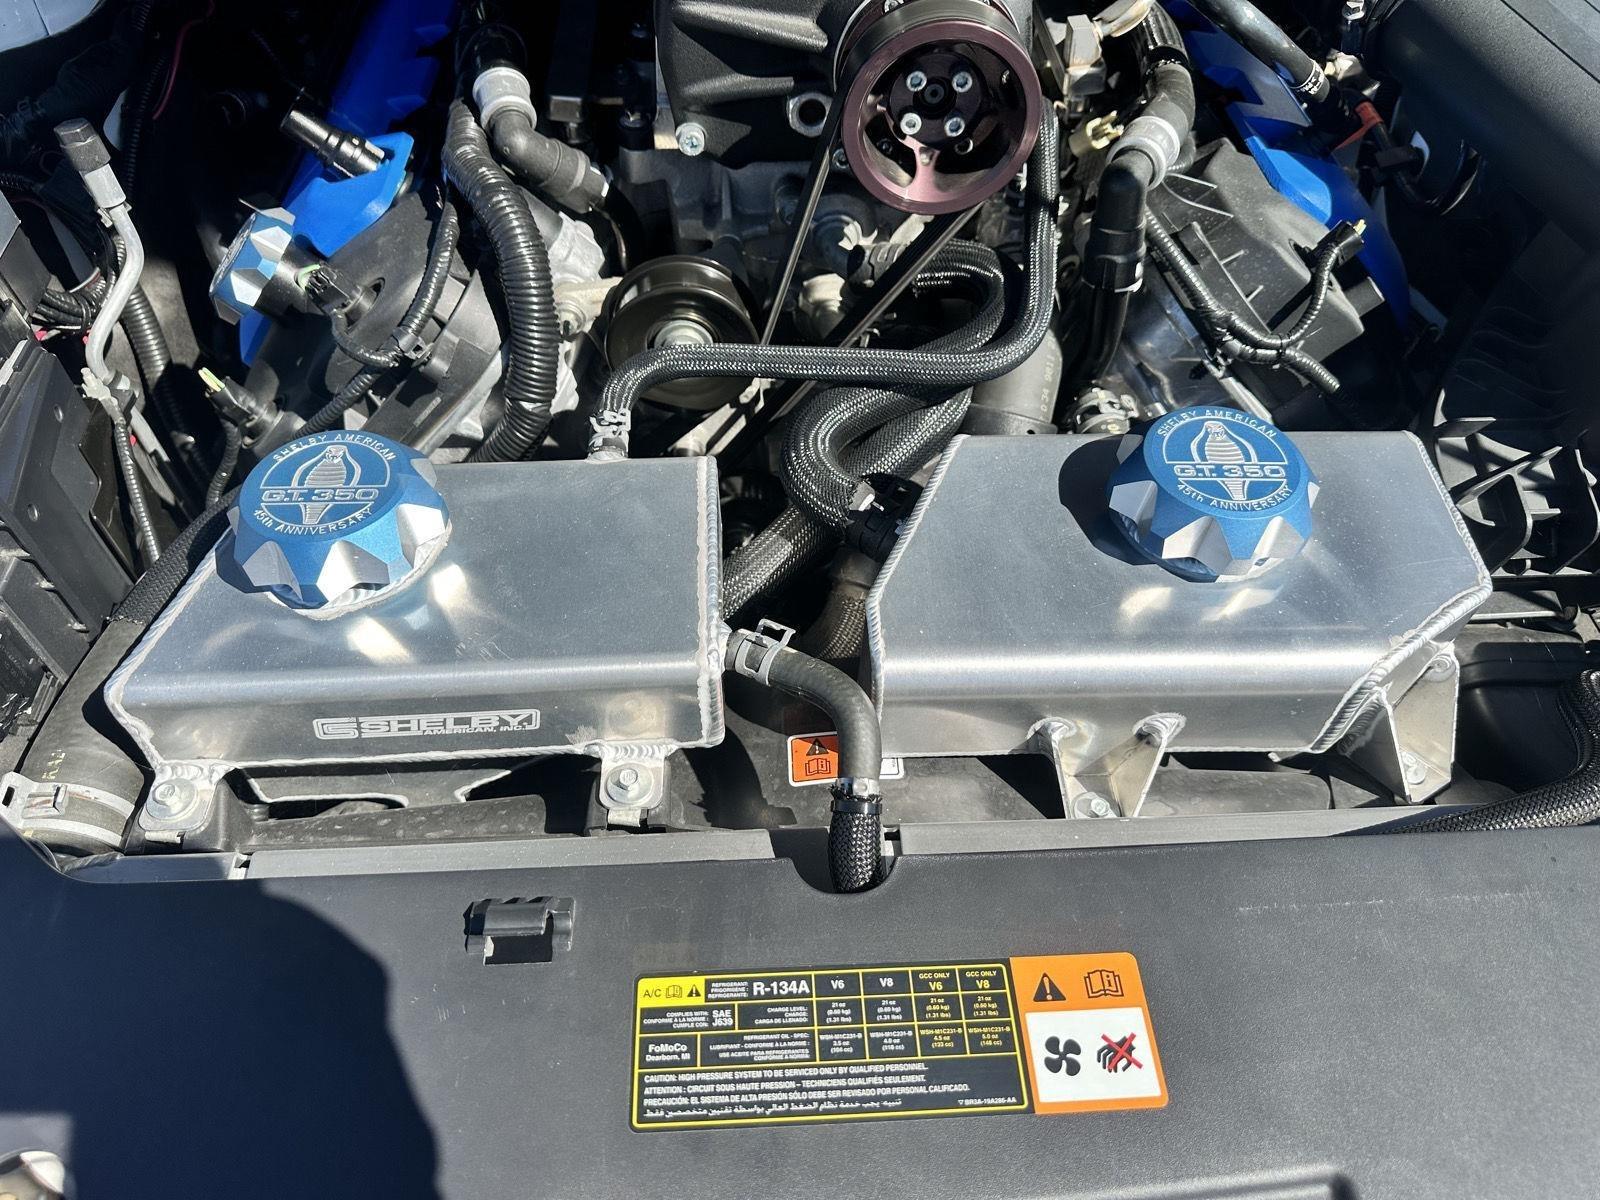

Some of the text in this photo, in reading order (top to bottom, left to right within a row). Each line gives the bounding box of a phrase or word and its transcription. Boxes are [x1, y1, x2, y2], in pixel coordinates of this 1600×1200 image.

[1158, 409, 1276, 438] SHELBY AMERICAN
[273, 433, 396, 462] SHELBY AMERICAN
[1174, 465, 1286, 477] G.T. 350
[262, 488, 379, 501] G.T. 350
[1177, 483, 1293, 511] 45th ANNIVERSARY
[254, 507, 372, 536] 45th ANNIVERSARY
[360, 713, 531, 732] SHELBY
[424, 726, 496, 735] AMERICAN,
[753, 980, 810, 995] R-134A
[831, 980, 844, 989] V6
[880, 978, 893, 987] V8
[929, 982, 942, 990] V6
[976, 980, 990, 988] V8
[644, 989, 661, 998] A/C
[713, 1010, 731, 1018] SAE
[712, 1018, 733, 1026] J639
[649, 1043, 687, 1052] FoMoCo
[644, 1074, 677, 1083] CAUTION:
[697, 1072, 733, 1080] PRESSURE
[734, 1071, 762, 1079] SYSTEM
[785, 1068, 818, 1076] SERVICED
[819, 1067, 837, 1075] ONLY
[849, 1065, 885, 1074] QUALIFIED
[886, 1063, 928, 1072] PERSONNEL.
[644, 1086, 682, 1094] ATTENTION
[687, 1085, 715, 1093] CIRCUIT
[716, 1084, 735, 1092] SOUS
[761, 1081, 796, 1089] PRESSION
[802, 1078, 846, 1088] TECHNICIENS
[848, 1076, 883, 1086] QUALIFIÉS
[884, 1075, 926, 1084] SEULEMENT.
[644, 1096, 689, 1106] PRECAUCIÓN:
[700, 1096, 730, 1104] SISTEMA
[758, 1092, 788, 1101] PRESIÓN
[788, 1091, 807, 1100] SÓLO
[842, 1088, 876, 1097] REVISADO
[892, 1086, 928, 1094] PERSONAL
[929, 1084, 970, 1093] CALIFICADO.
